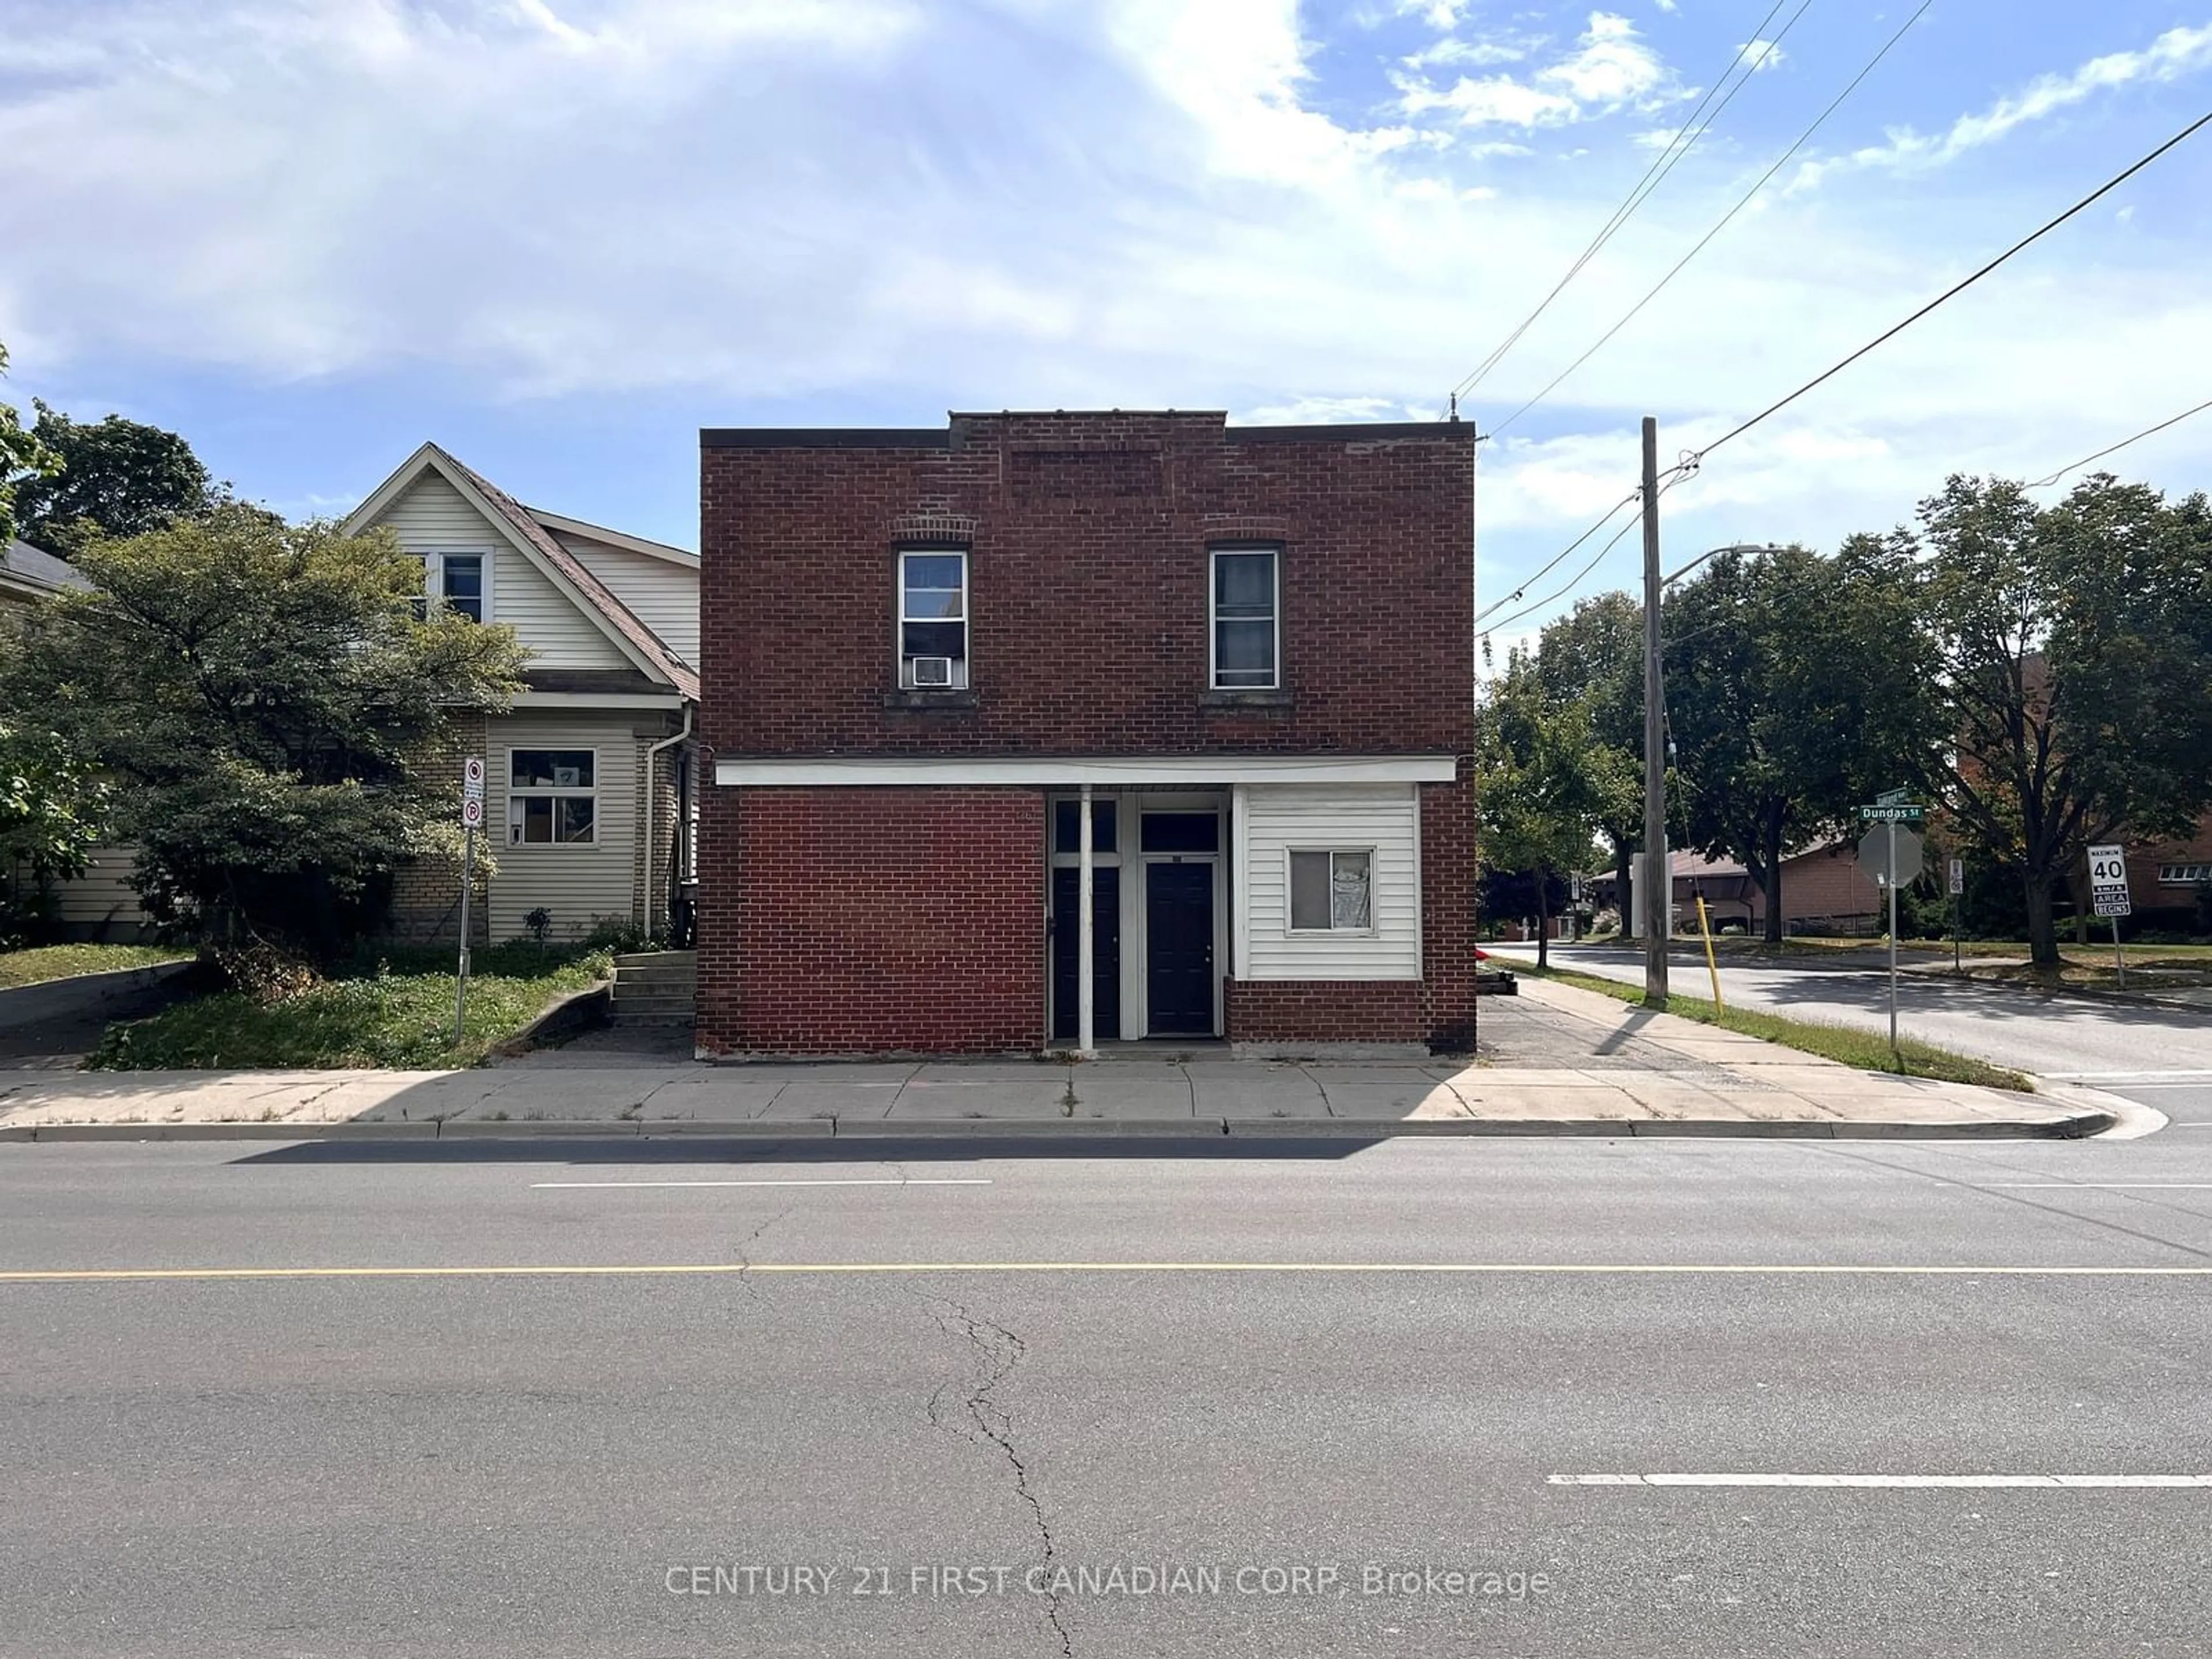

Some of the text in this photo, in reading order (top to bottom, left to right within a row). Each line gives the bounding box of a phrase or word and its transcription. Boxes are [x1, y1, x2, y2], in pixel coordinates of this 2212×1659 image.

[1863, 808, 1919, 818] Dundas St
[2094, 861, 2122, 878] 40
[2097, 894, 2125, 903] AREA
[2098, 906, 2127, 914] BEGINS
